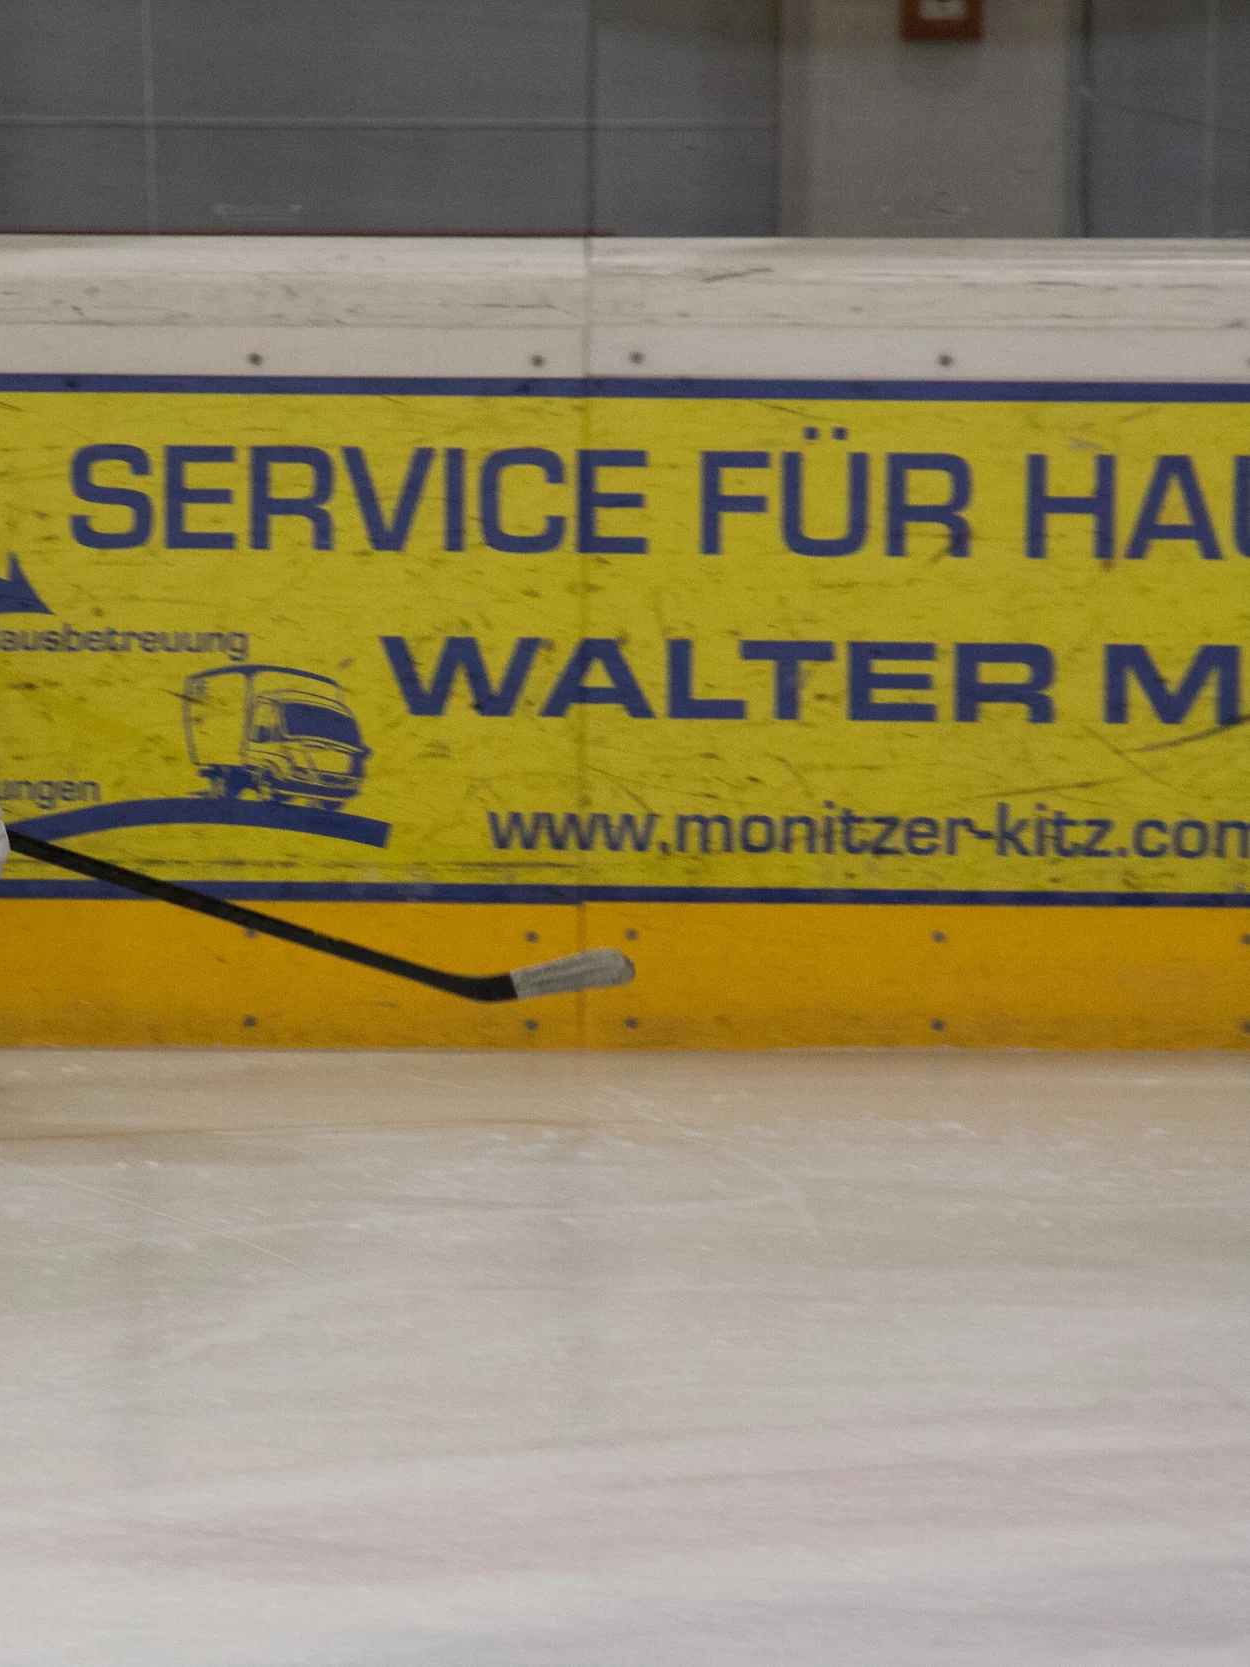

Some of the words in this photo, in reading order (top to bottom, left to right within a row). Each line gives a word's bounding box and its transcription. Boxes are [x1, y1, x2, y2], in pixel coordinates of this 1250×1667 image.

[68, 443, 648, 555] SERVICE
[699, 426, 975, 559] FÜR
[1023, 453, 1250, 561] HA
[378, 635, 1057, 724] WALTER
